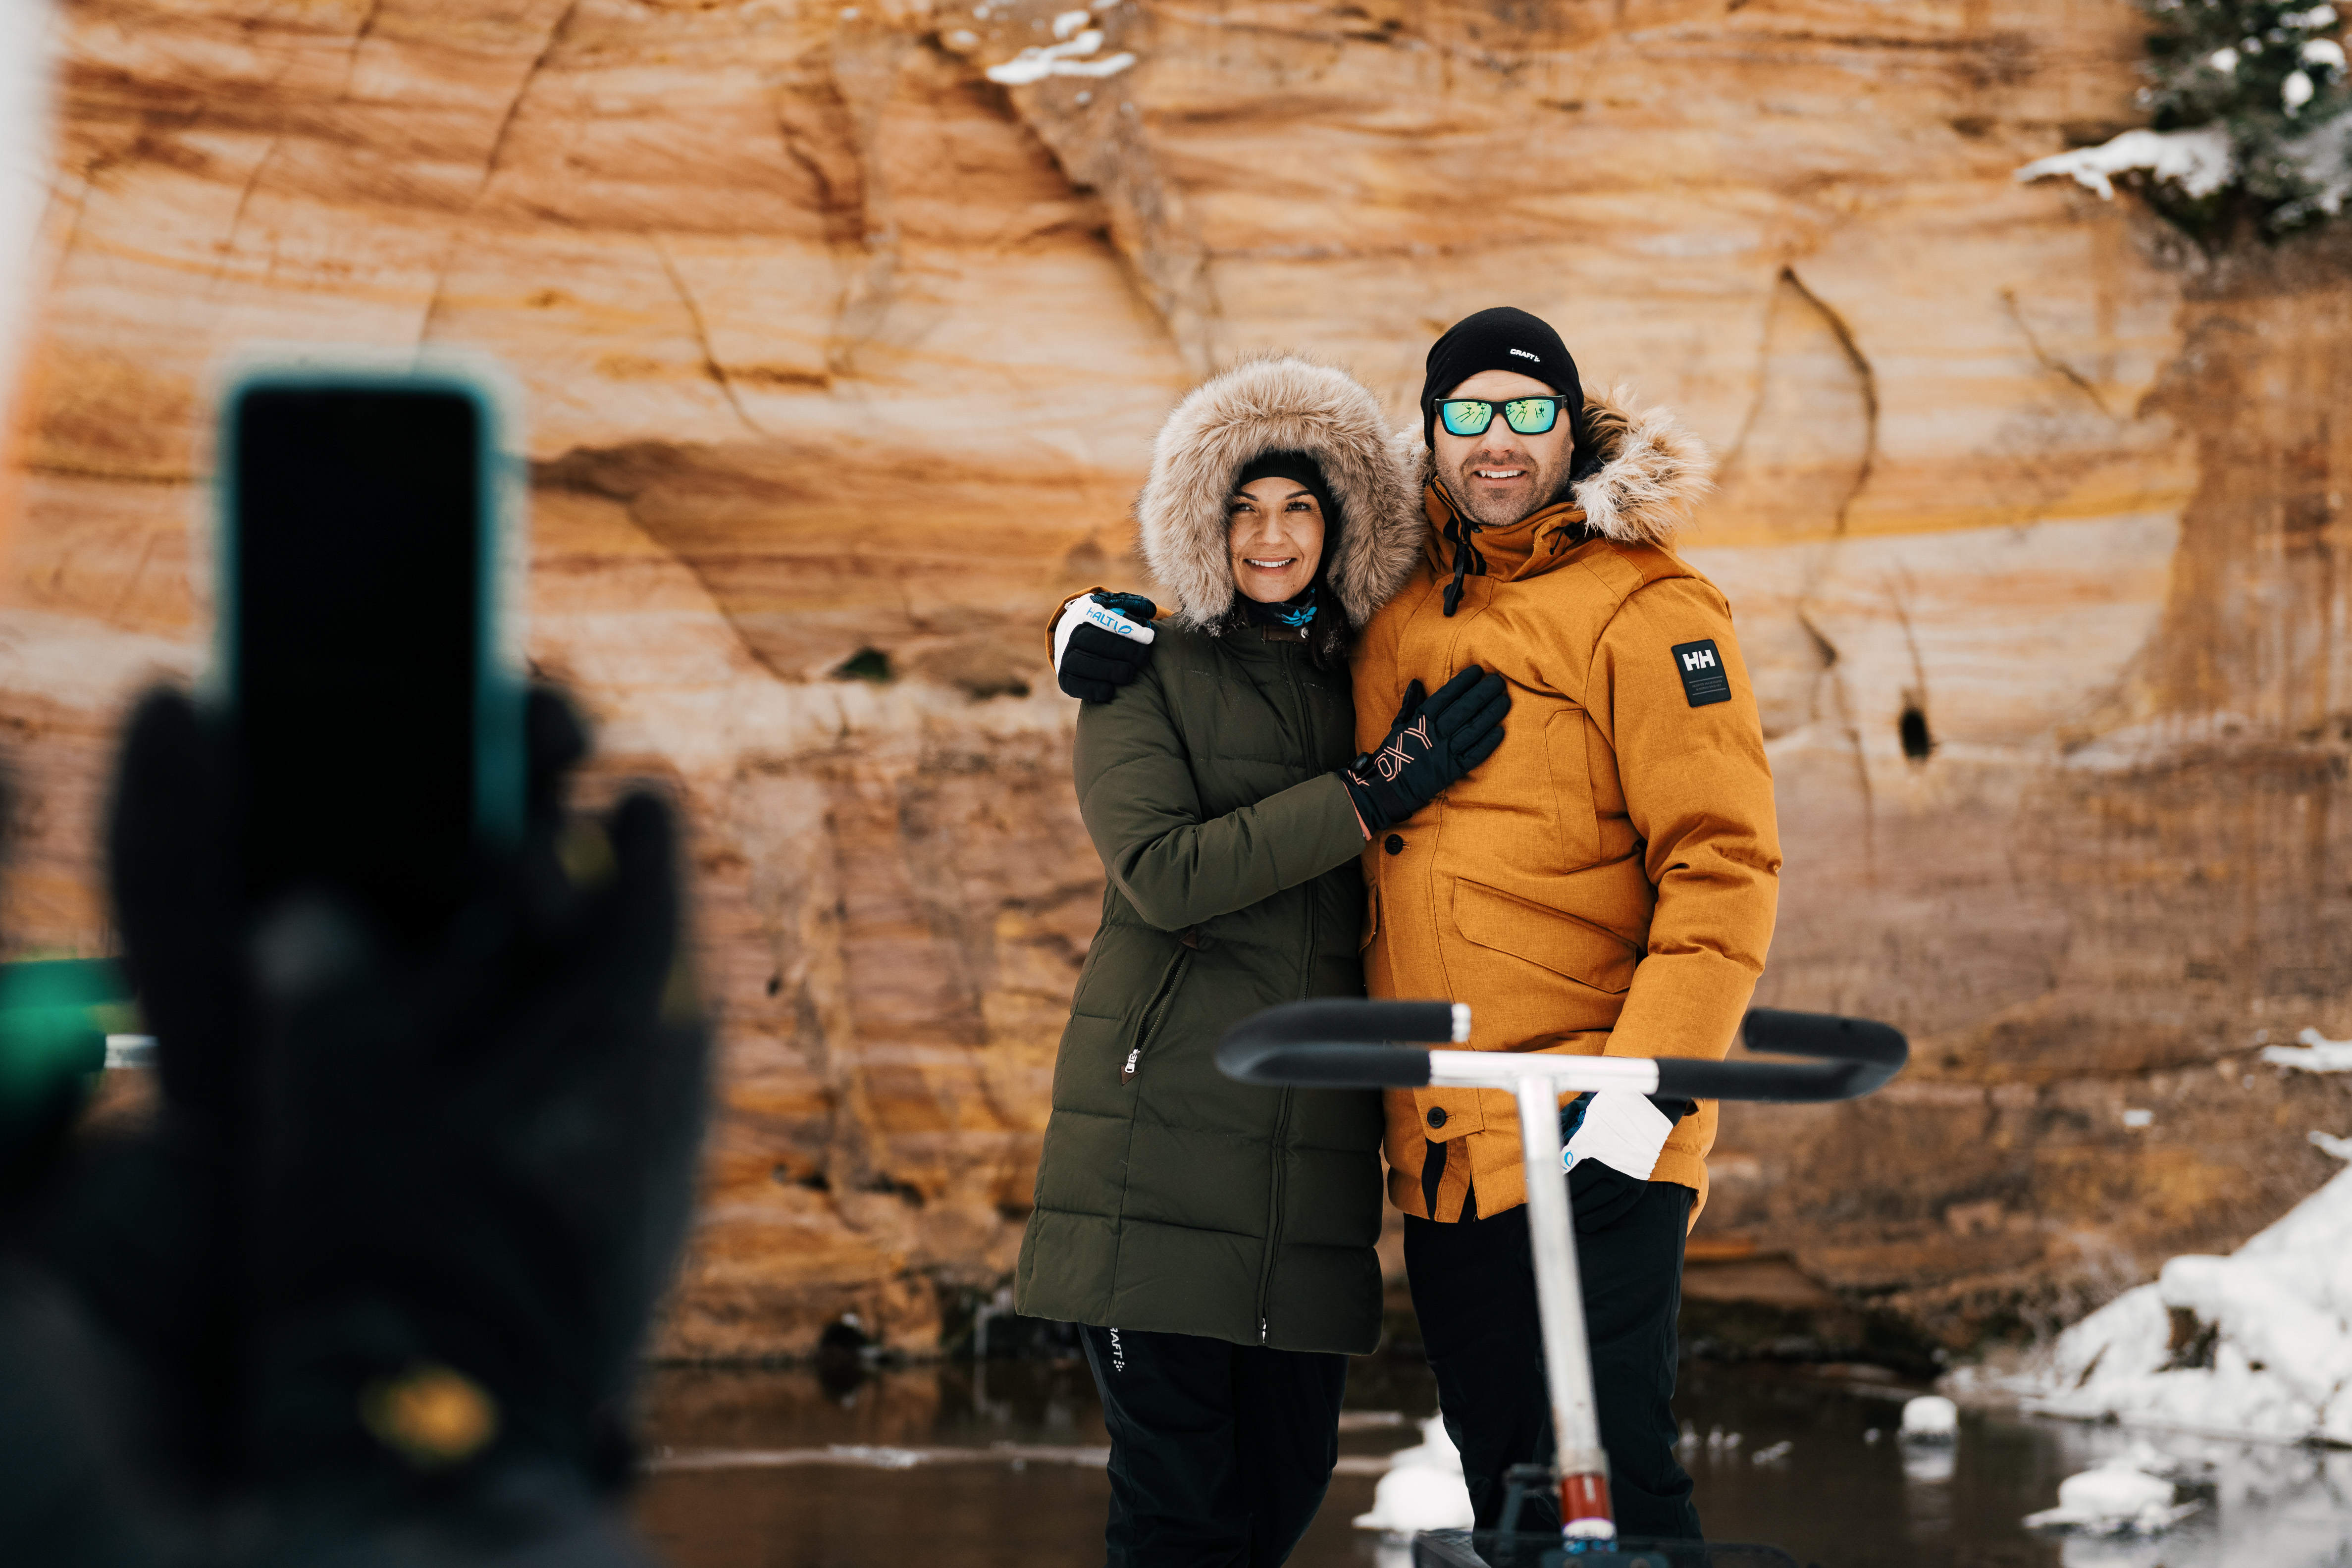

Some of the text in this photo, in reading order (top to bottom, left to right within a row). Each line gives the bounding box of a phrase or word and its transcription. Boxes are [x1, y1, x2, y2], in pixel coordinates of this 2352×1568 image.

[1510, 348, 1535, 360] CRAFT
[1086, 607, 1118, 630] HALTI
[1682, 649, 1716, 671] HH
